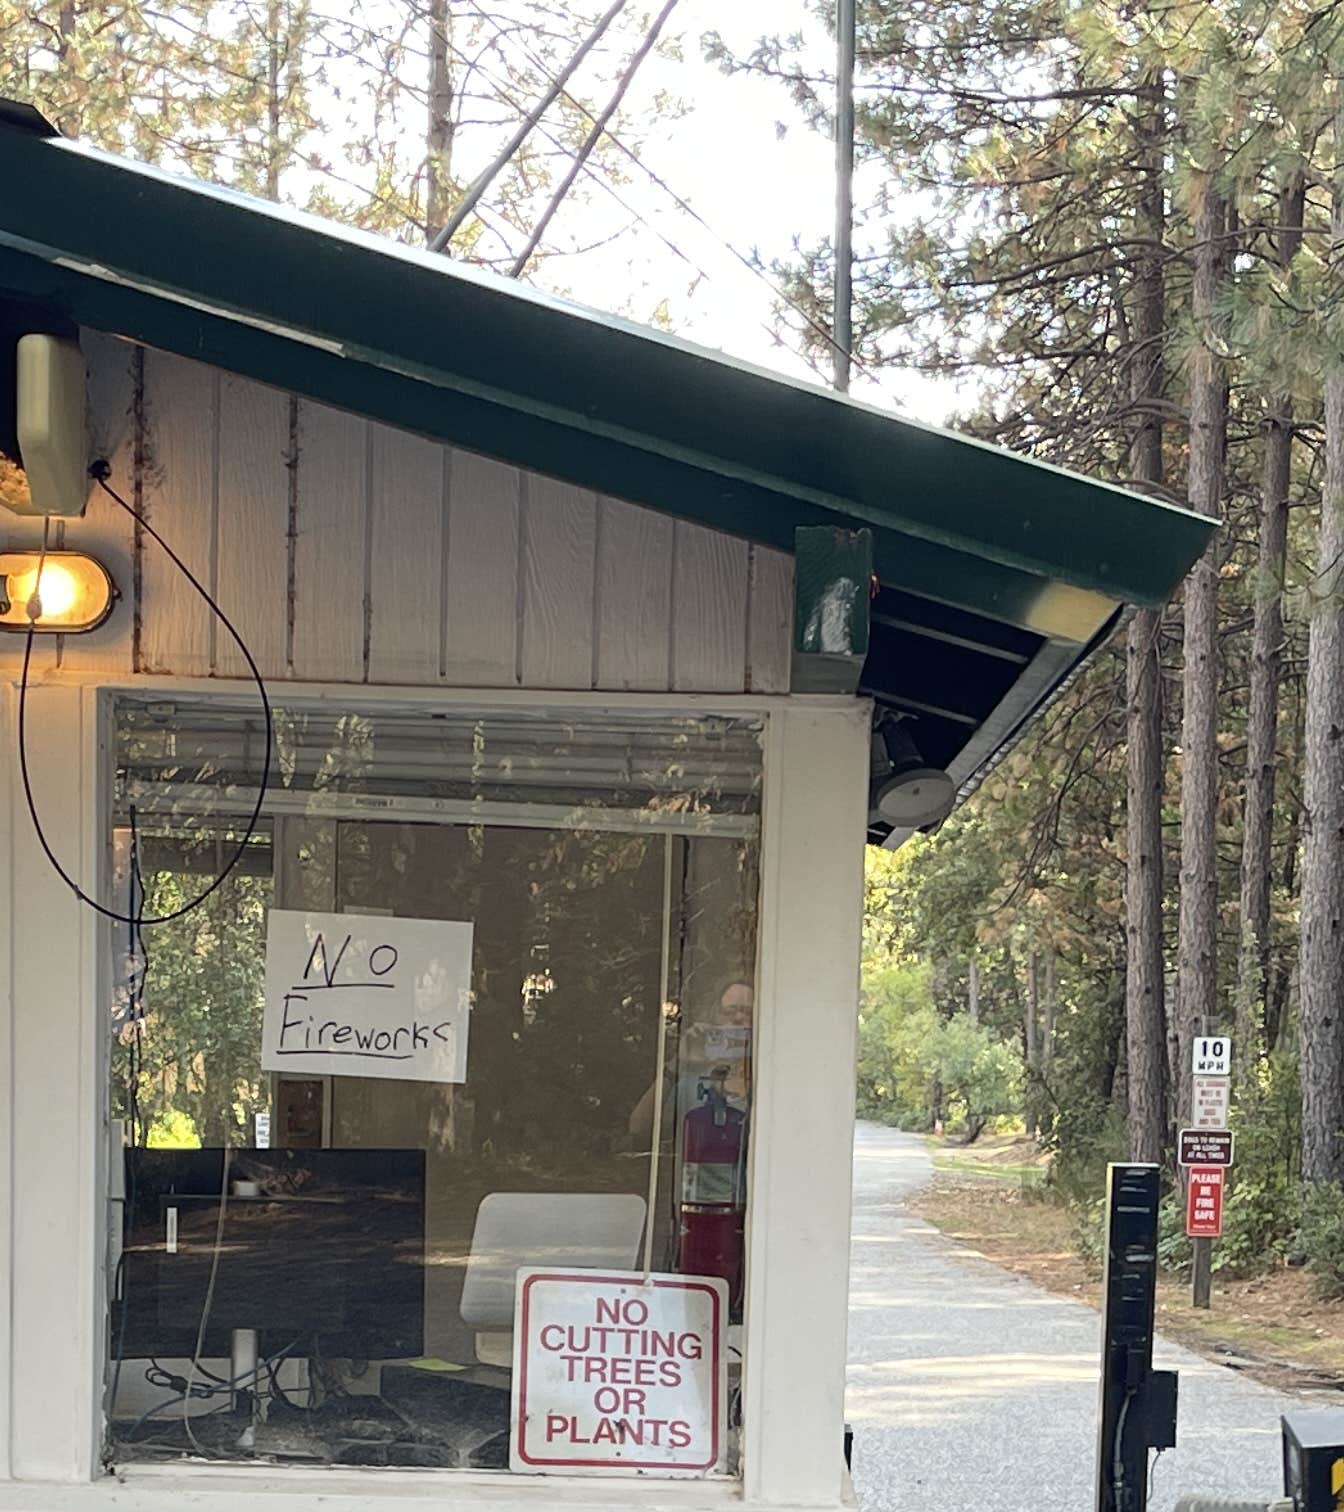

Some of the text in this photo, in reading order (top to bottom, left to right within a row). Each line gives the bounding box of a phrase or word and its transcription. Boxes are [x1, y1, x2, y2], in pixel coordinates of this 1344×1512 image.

[279, 993, 452, 1051] Fireworks
[1202, 1040, 1224, 1057] 10
[1198, 1061, 1224, 1071] MPH
[1191, 1173, 1221, 1184] PLEASE
[595, 1296, 650, 1327] NO
[539, 1324, 703, 1361] CUTTING
[559, 1355, 683, 1388] TREES
[593, 1386, 648, 1416] OR
[545, 1414, 693, 1448] PLANTS
